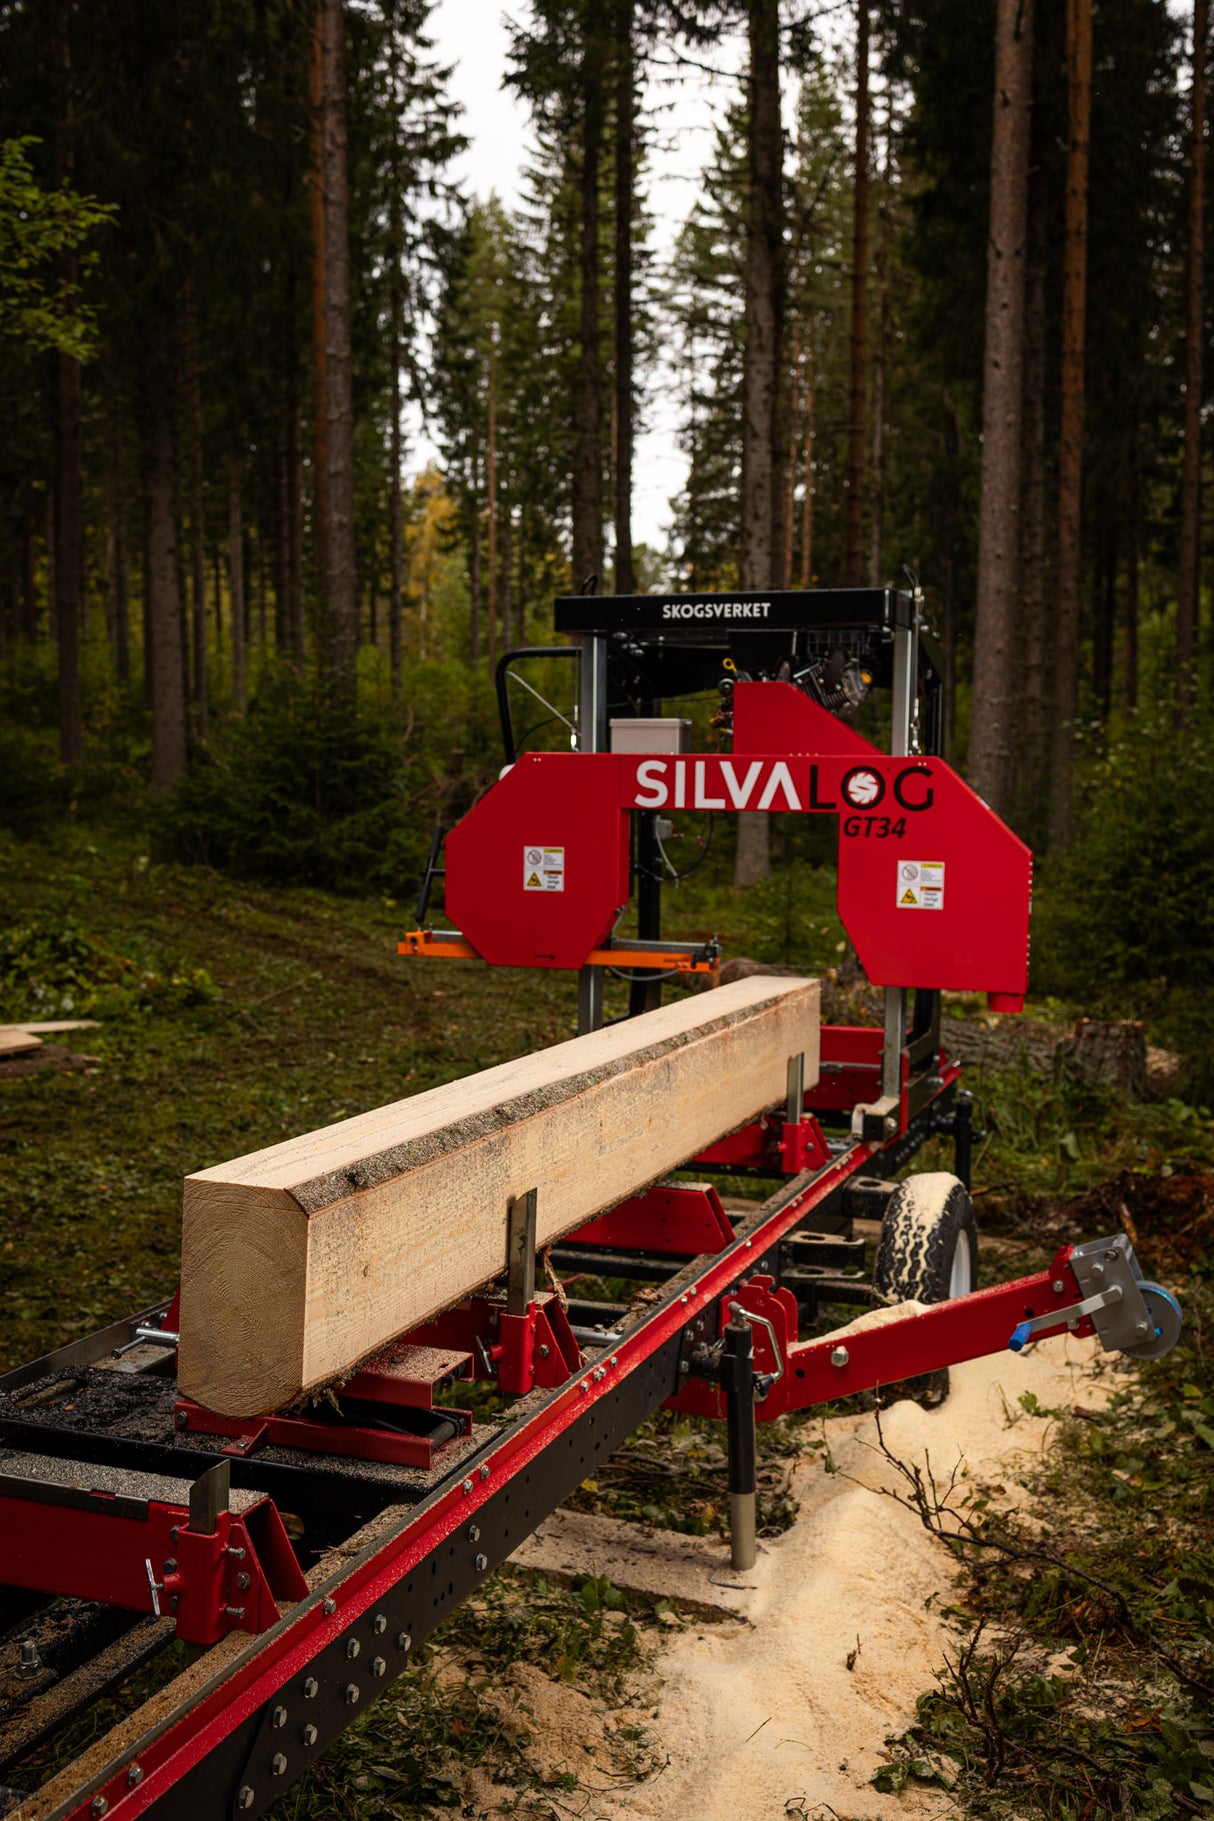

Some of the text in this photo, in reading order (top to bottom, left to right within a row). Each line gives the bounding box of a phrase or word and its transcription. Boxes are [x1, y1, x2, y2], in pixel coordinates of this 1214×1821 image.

[662, 602, 771, 619] SKOGSVERKET
[634, 760, 934, 811] SILVALOG
[843, 816, 906, 838] GT34
